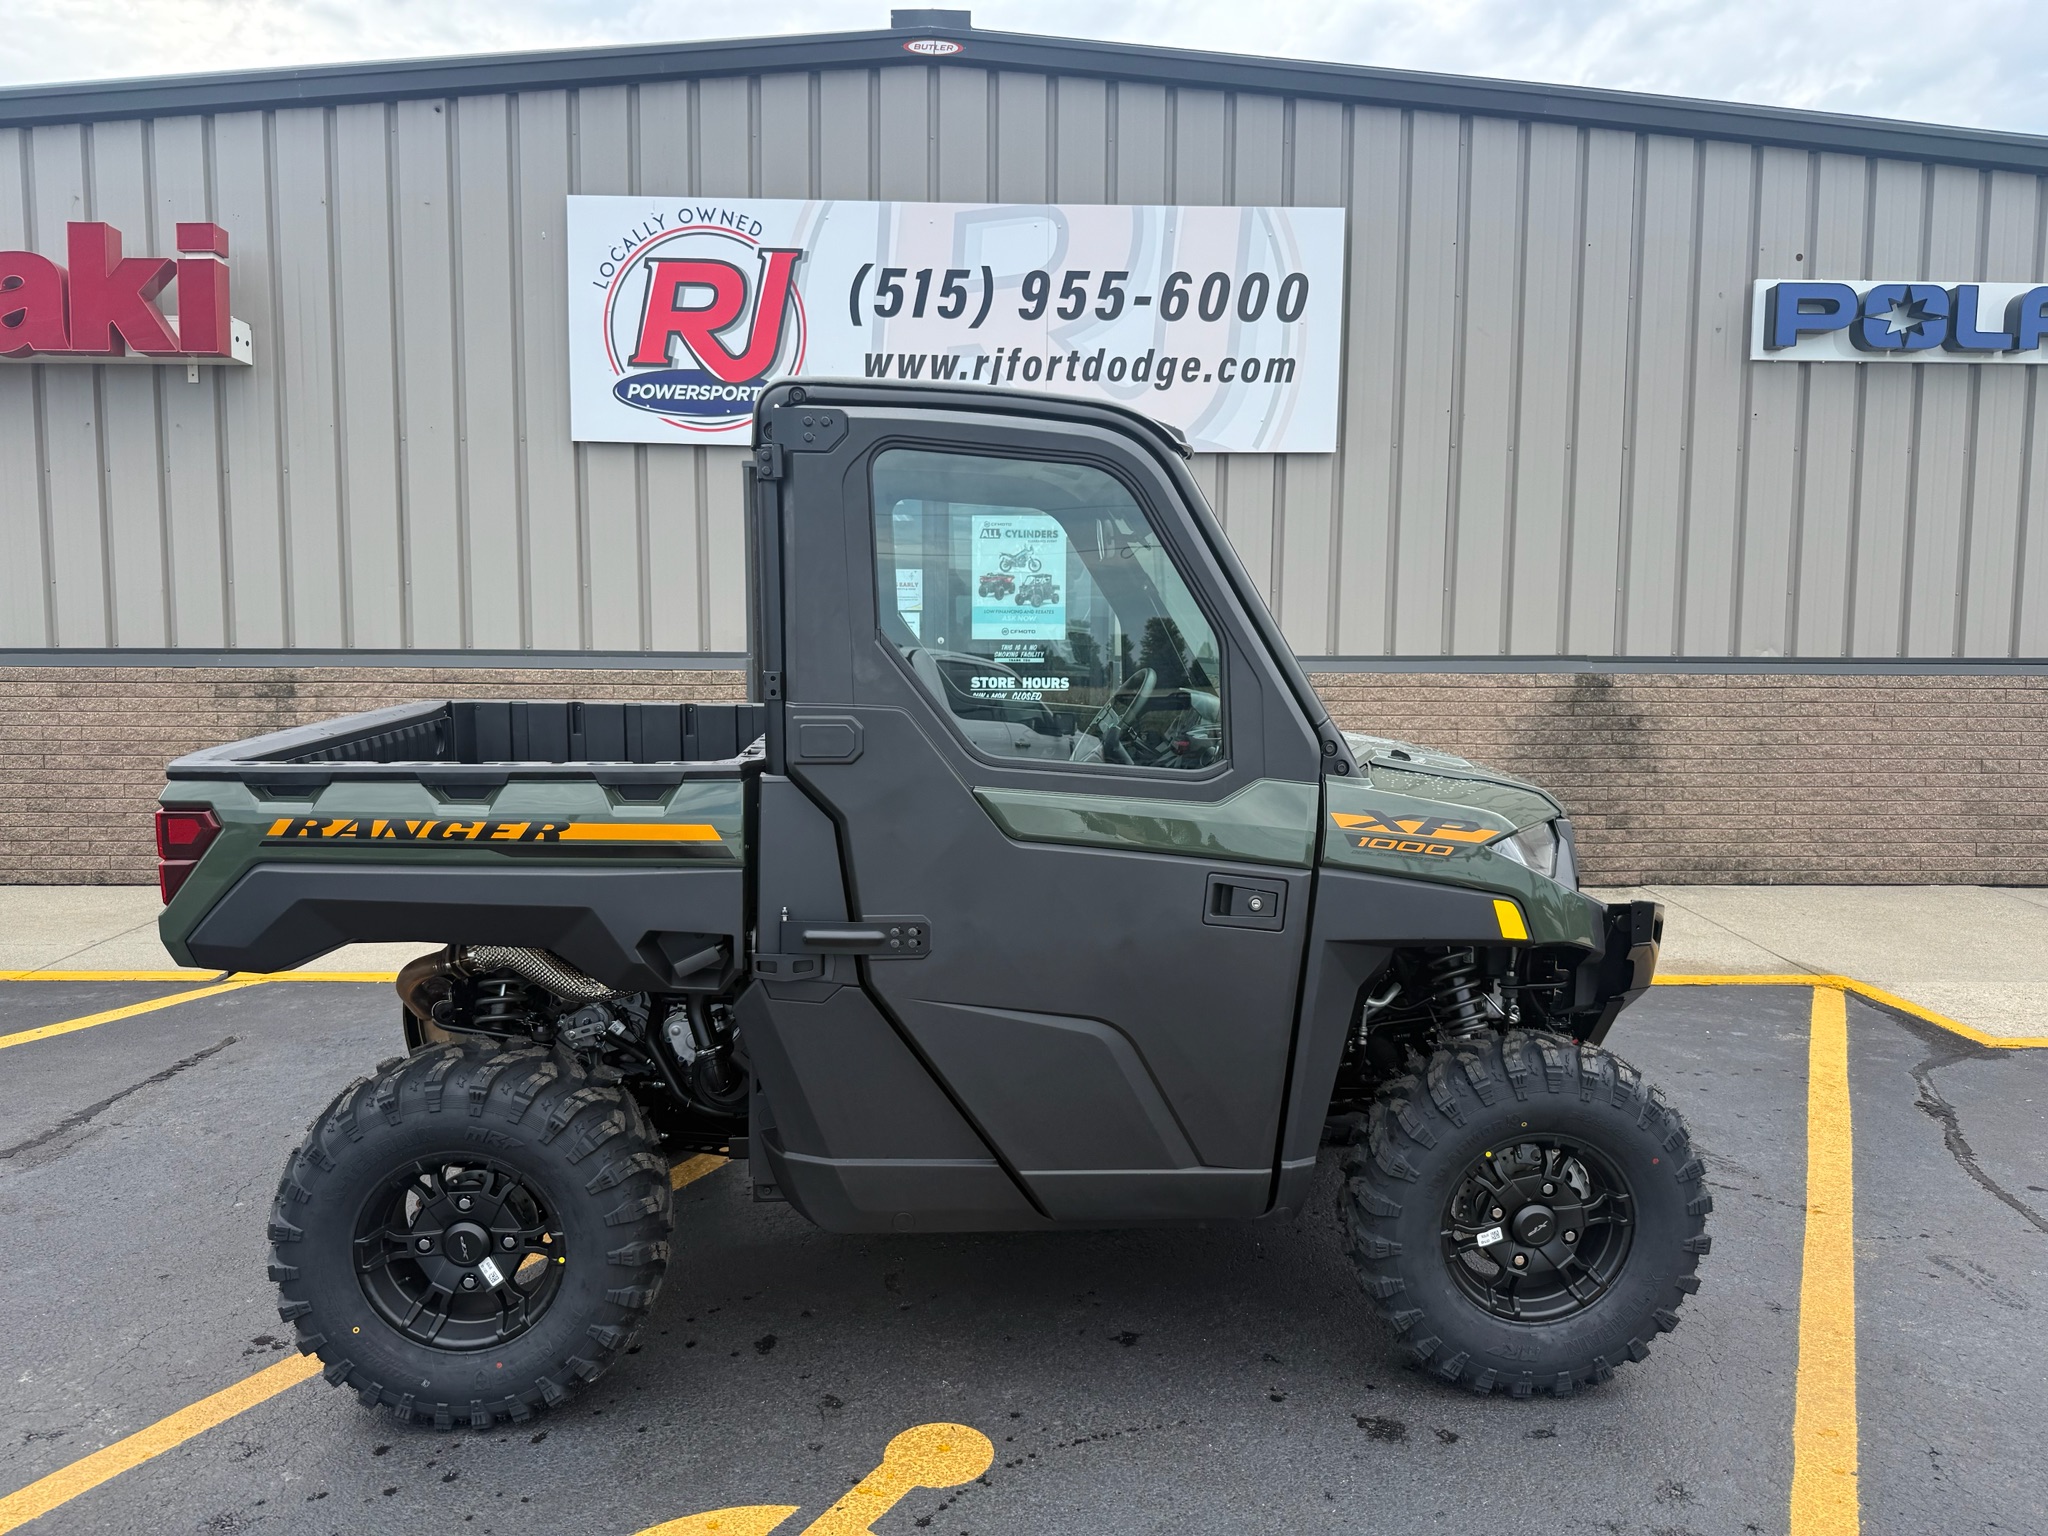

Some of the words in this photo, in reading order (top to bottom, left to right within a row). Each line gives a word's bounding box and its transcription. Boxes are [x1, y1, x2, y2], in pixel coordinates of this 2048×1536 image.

[914, 43, 954, 51] BUTLER
[592, 213, 666, 290] LOCALLY
[678, 206, 763, 237] OWNED
[849, 263, 995, 329] (515)
[1017, 269, 1310, 323] 955-6000
[627, 247, 804, 384] RJ
[864, 347, 1297, 391] www.rjfortdodge.com
[627, 384, 763, 402] POWERSPORT
[981, 529, 1000, 538] ALL
[1005, 530, 1059, 539] CYLINDERS
[971, 677, 1016, 689] STORE
[1022, 677, 1070, 689] HOURS
[1012, 691, 1042, 701] CLOSED
[280, 817, 571, 842] RANGER
[1344, 809, 1484, 836] XP
[1357, 836, 1455, 857] 1000
